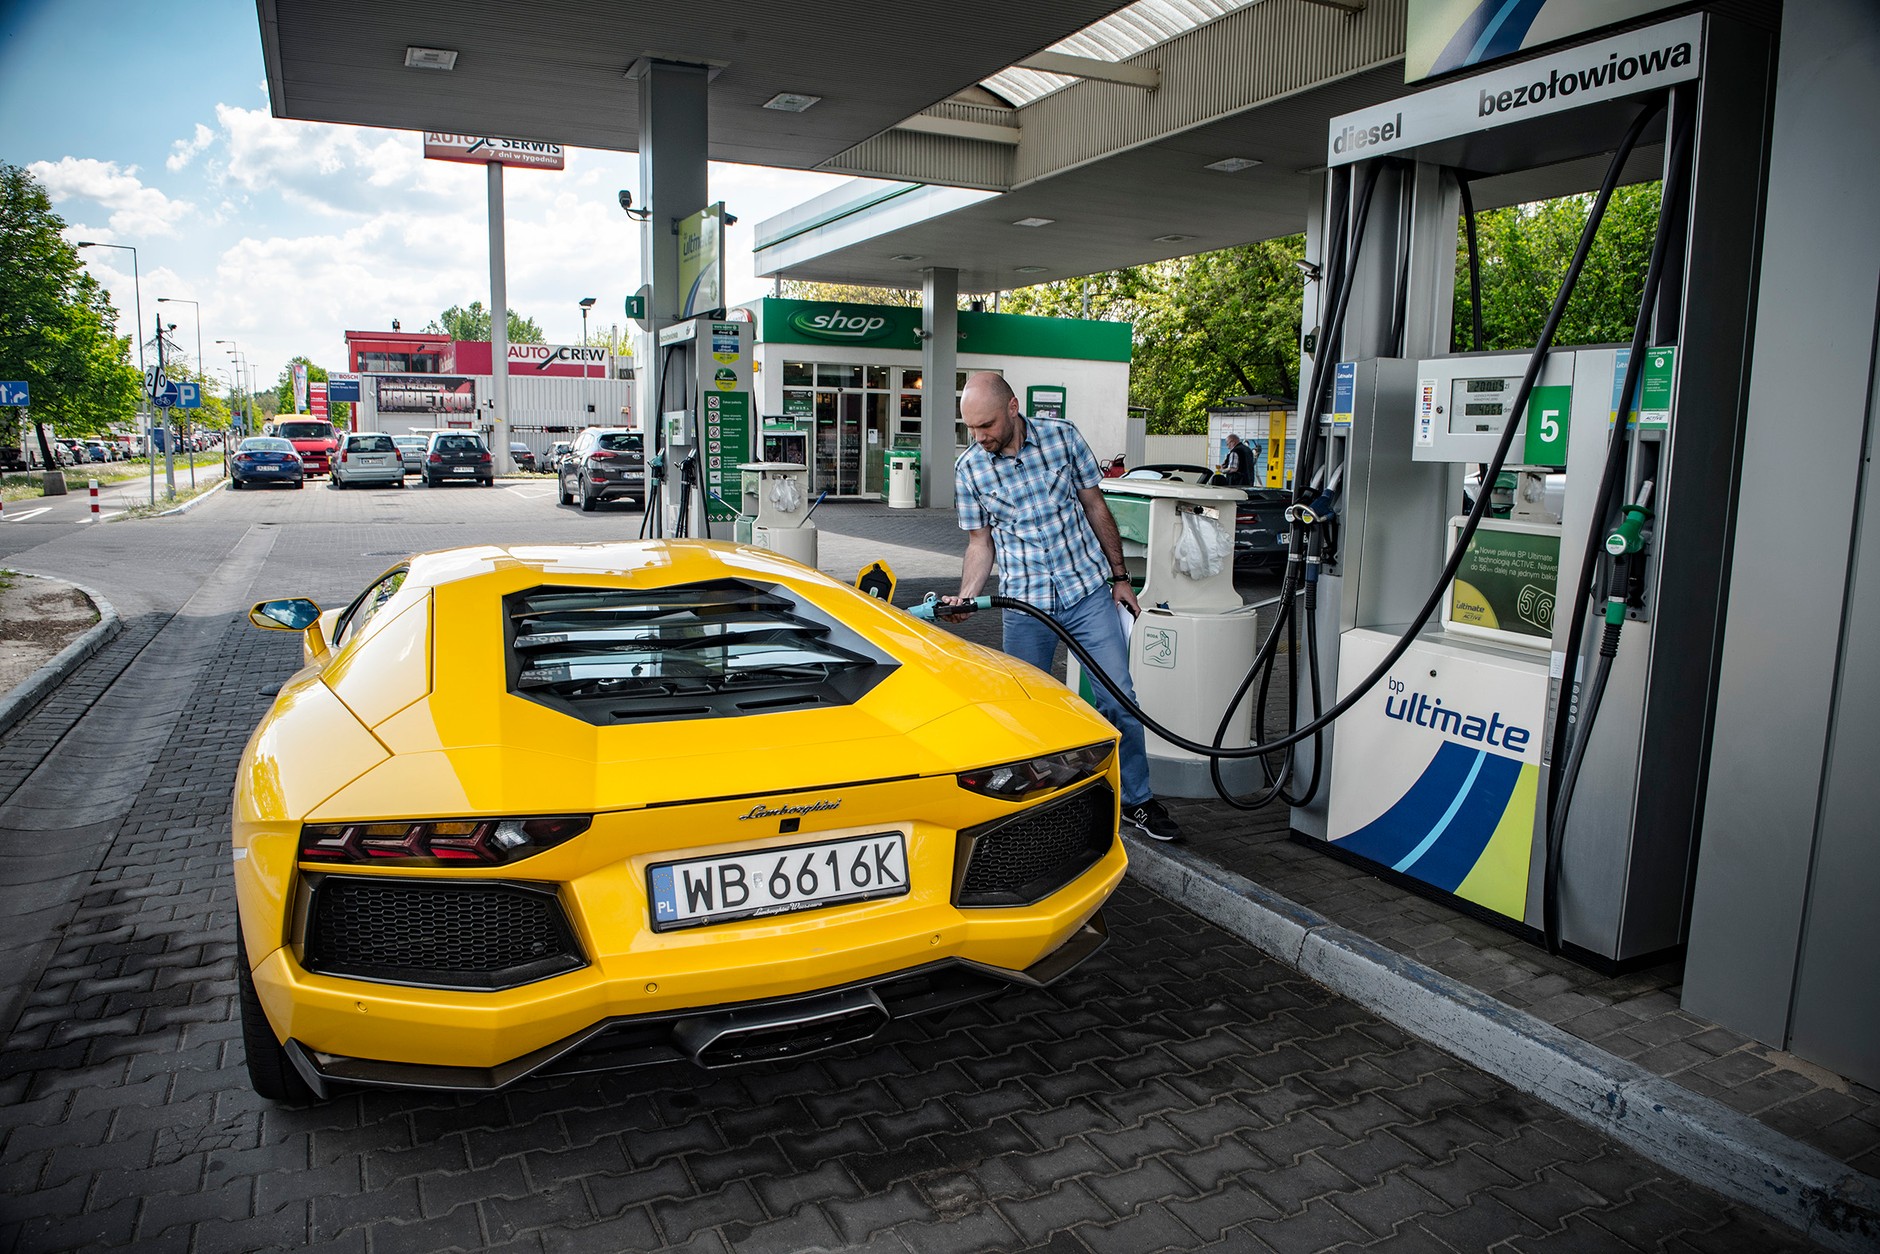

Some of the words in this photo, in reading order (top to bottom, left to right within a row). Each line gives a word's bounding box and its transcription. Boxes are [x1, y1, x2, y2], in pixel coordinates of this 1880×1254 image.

[1478, 42, 1692, 118] bezołowiowa
[1333, 113, 1402, 155] diesel
[501, 139, 560, 154] SERWIS
[489, 149, 495, 157] 7
[498, 151, 512, 159] dni
[522, 153, 558, 164] tygodniu
[630, 300, 638, 314] 1
[813, 309, 885, 337] shop
[1306, 338, 1313, 349] 3
[508, 346, 550, 359] AUTO
[180, 385, 196, 406] P
[1540, 409, 1559, 443] 5
[1497, 548, 1516, 558] paliwa
[1517, 551, 1527, 559] BP
[1527, 551, 1553, 562] Ultimate
[1494, 566, 1508, 576] dalej
[1517, 569, 1540, 579] jednym
[1456, 602, 1485, 613] ultimate
[1388, 675, 1405, 695] bp
[1385, 692, 1530, 753] ultimate
[738, 797, 842, 821] Lamborghini
[683, 863, 750, 914] WB
[768, 841, 901, 900] 6616K
[658, 901, 674, 915] PL
